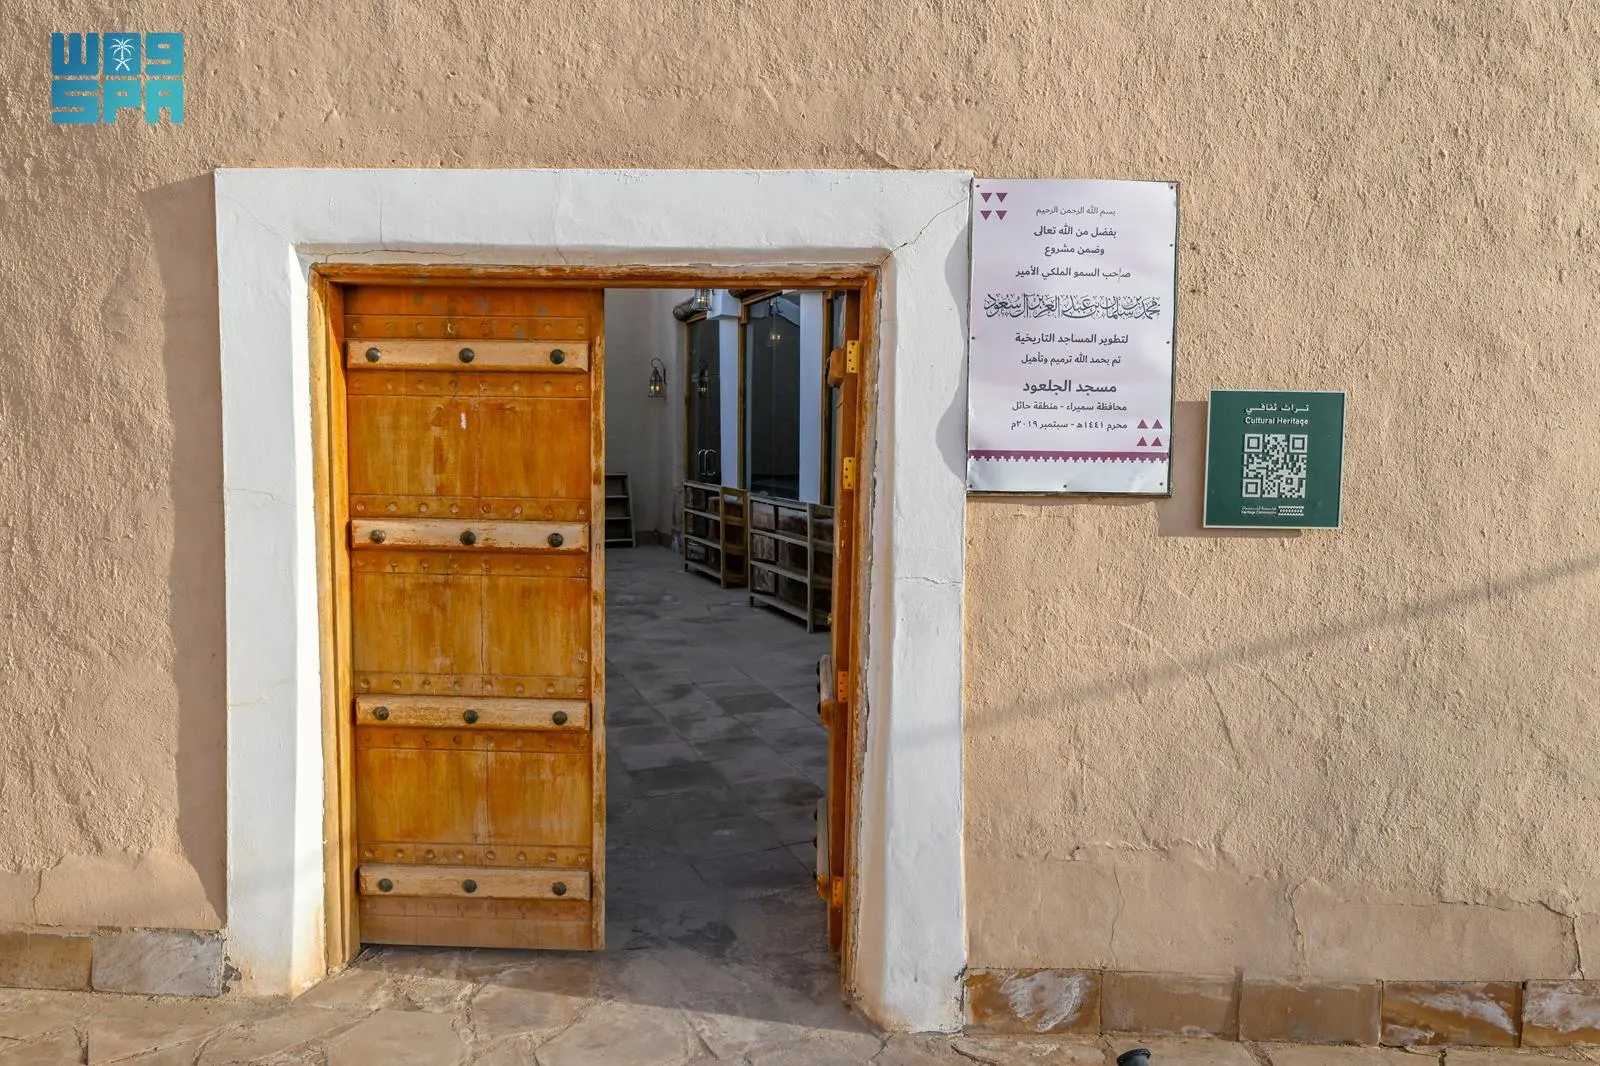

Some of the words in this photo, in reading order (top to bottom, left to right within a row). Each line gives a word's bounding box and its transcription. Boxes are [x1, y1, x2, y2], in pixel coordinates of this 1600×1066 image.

[1036, 206, 1058, 215] الرحيم
[1060, 207, 1084, 215] الرحمن
[1087, 206, 1098, 214] الله
[1034, 226, 1056, 236] تعالى
[1059, 223, 1072, 235] الله
[1076, 227, 1088, 237] من
[1092, 227, 1116, 238] بفضل
[1045, 245, 1074, 256] مشروع
[1077, 246, 1104, 255] وضمن
[1016, 266, 1038, 278] الأمير
[1043, 268, 1071, 280] الملكي
[1074, 269, 1099, 278] السمو
[1102, 268, 1130, 282] صاحب
[1015, 333, 1055, 344] التاريخية
[1058, 334, 1097, 345] المساجد
[1099, 334, 1128, 345] لتطوير
[1021, 353, 1047, 365] وتأهيل
[1050, 356, 1072, 366] ترميم
[1074, 353, 1088, 364] الله
[1090, 356, 1109, 364] بحمد
[1111, 356, 1120, 366] تم
[1023, 380, 1072, 395] الجلعود
[1076, 382, 1116, 396] مسجد
[1012, 402, 1031, 411] حائل
[1033, 402, 1058, 411] منطقة
[1066, 402, 1094, 411] سميراء
[1097, 402, 1126, 411] محافظة
[1039, 421, 1068, 429] سبتمبر
[1107, 422, 1127, 431] محرم
[1245, 416, 1275, 425] Cultural
[1277, 417, 1309, 427] Heritage
